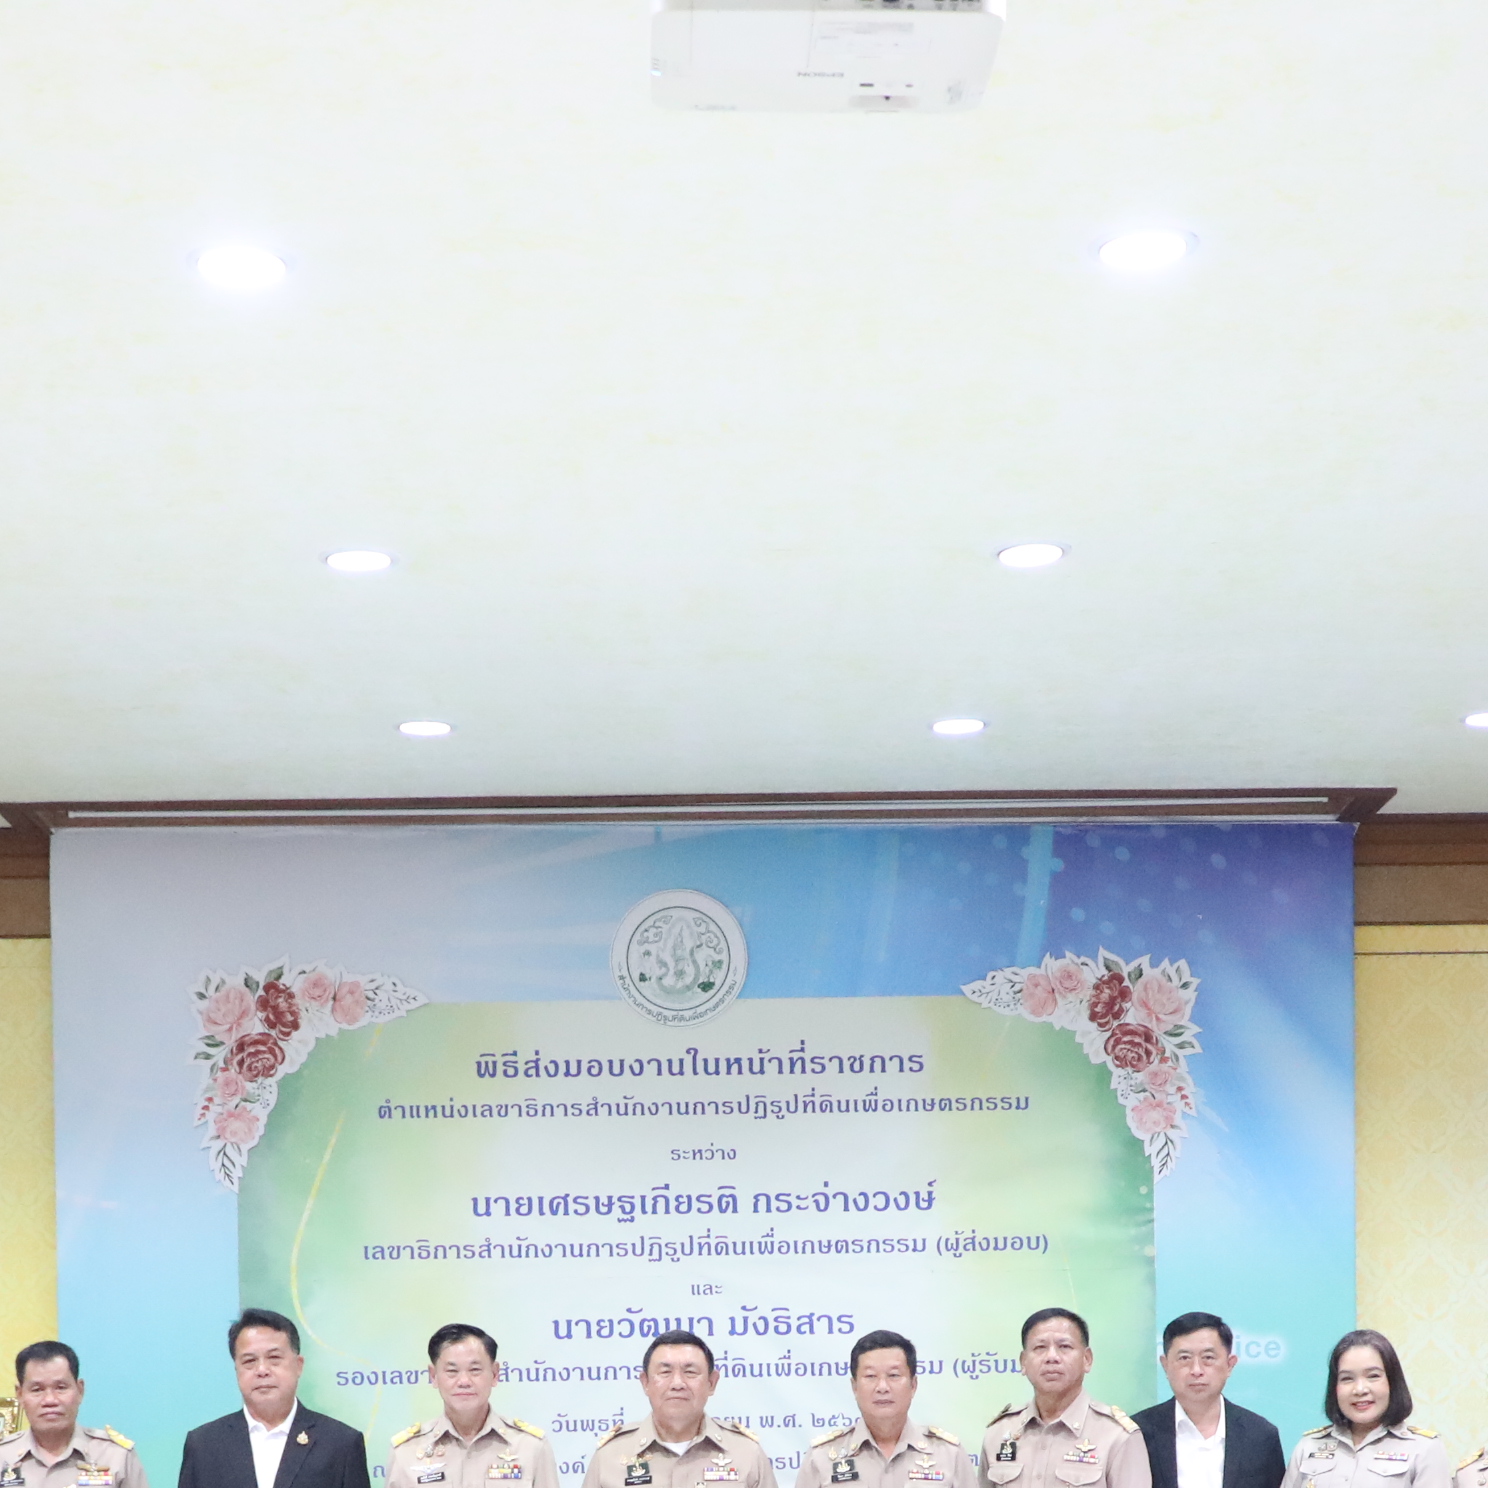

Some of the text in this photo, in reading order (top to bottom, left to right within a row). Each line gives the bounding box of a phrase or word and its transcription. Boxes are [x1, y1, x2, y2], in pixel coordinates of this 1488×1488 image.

[475, 1040, 925, 1080] พิธีส่งมอบงานในหน้าที่ราชการ
[378, 1087, 1030, 1121] ตำแหน่งเลขาธิการสำนักงานการปฏิรูปที่ดินเพื่อเกษตรกรรม
[671, 1142, 737, 1161] ระหว่าง
[471, 1179, 937, 1223] นายเศรษฐเกียรติ กระจ่างวงษ์
[363, 1227, 1049, 1263] เลขาธิการสำนักงานการปฏิรูปที่ดินเพื่อเกษตรกรรม (ผู้ส่งมอบ)
[691, 1283, 724, 1297] และ
[728, 1305, 855, 1337] มังธิสาร
[952, 1352, 1023, 1381] (ผู้รับม
[759, 1412, 803, 1428] พ.ศ.
